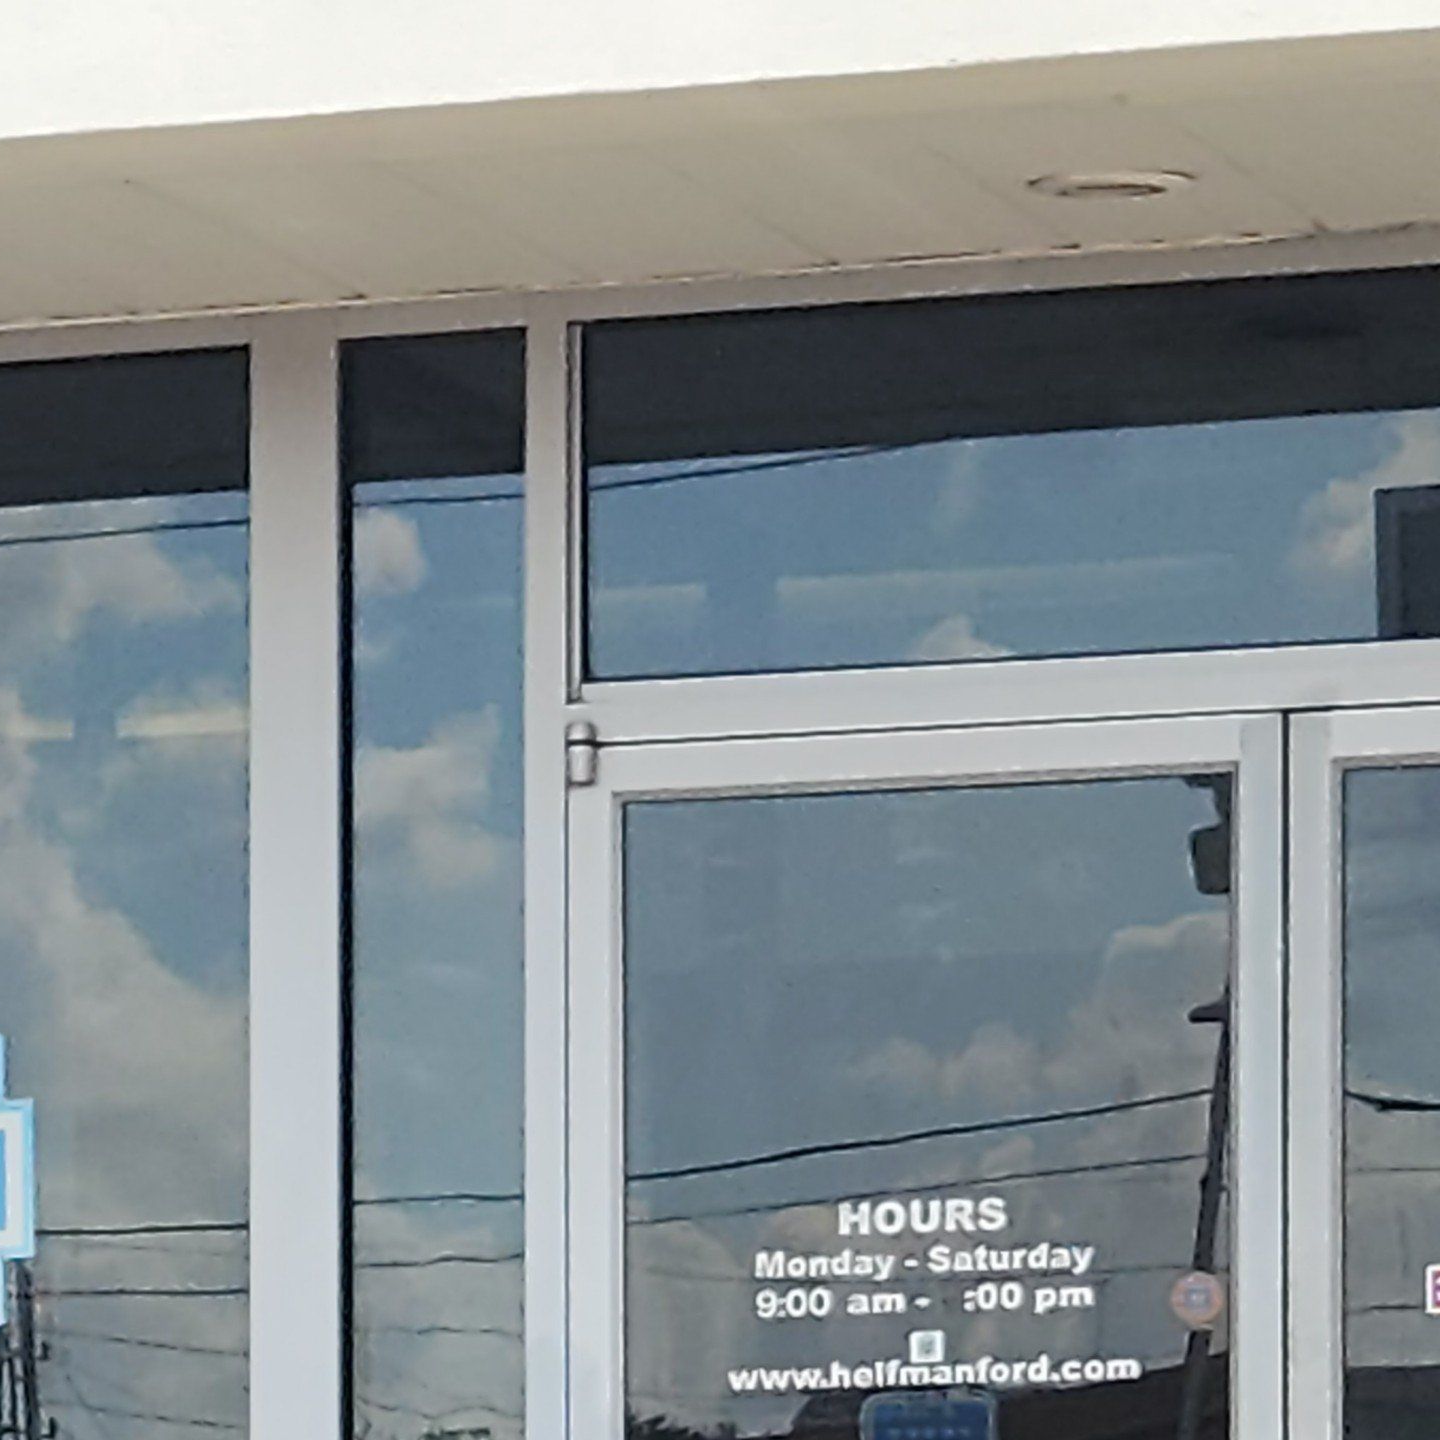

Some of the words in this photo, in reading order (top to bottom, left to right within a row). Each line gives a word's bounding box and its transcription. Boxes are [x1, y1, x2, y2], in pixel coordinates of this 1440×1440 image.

[837, 1197, 1008, 1236] HOURS
[754, 1249, 895, 1281] Monday
[926, 1242, 1096, 1276] Saturday
[754, 1286, 832, 1320] 9:00
[846, 1291, 908, 1315] am
[1033, 1284, 1095, 1315] pm
[727, 1353, 1142, 1393] www.helfmanford.com
